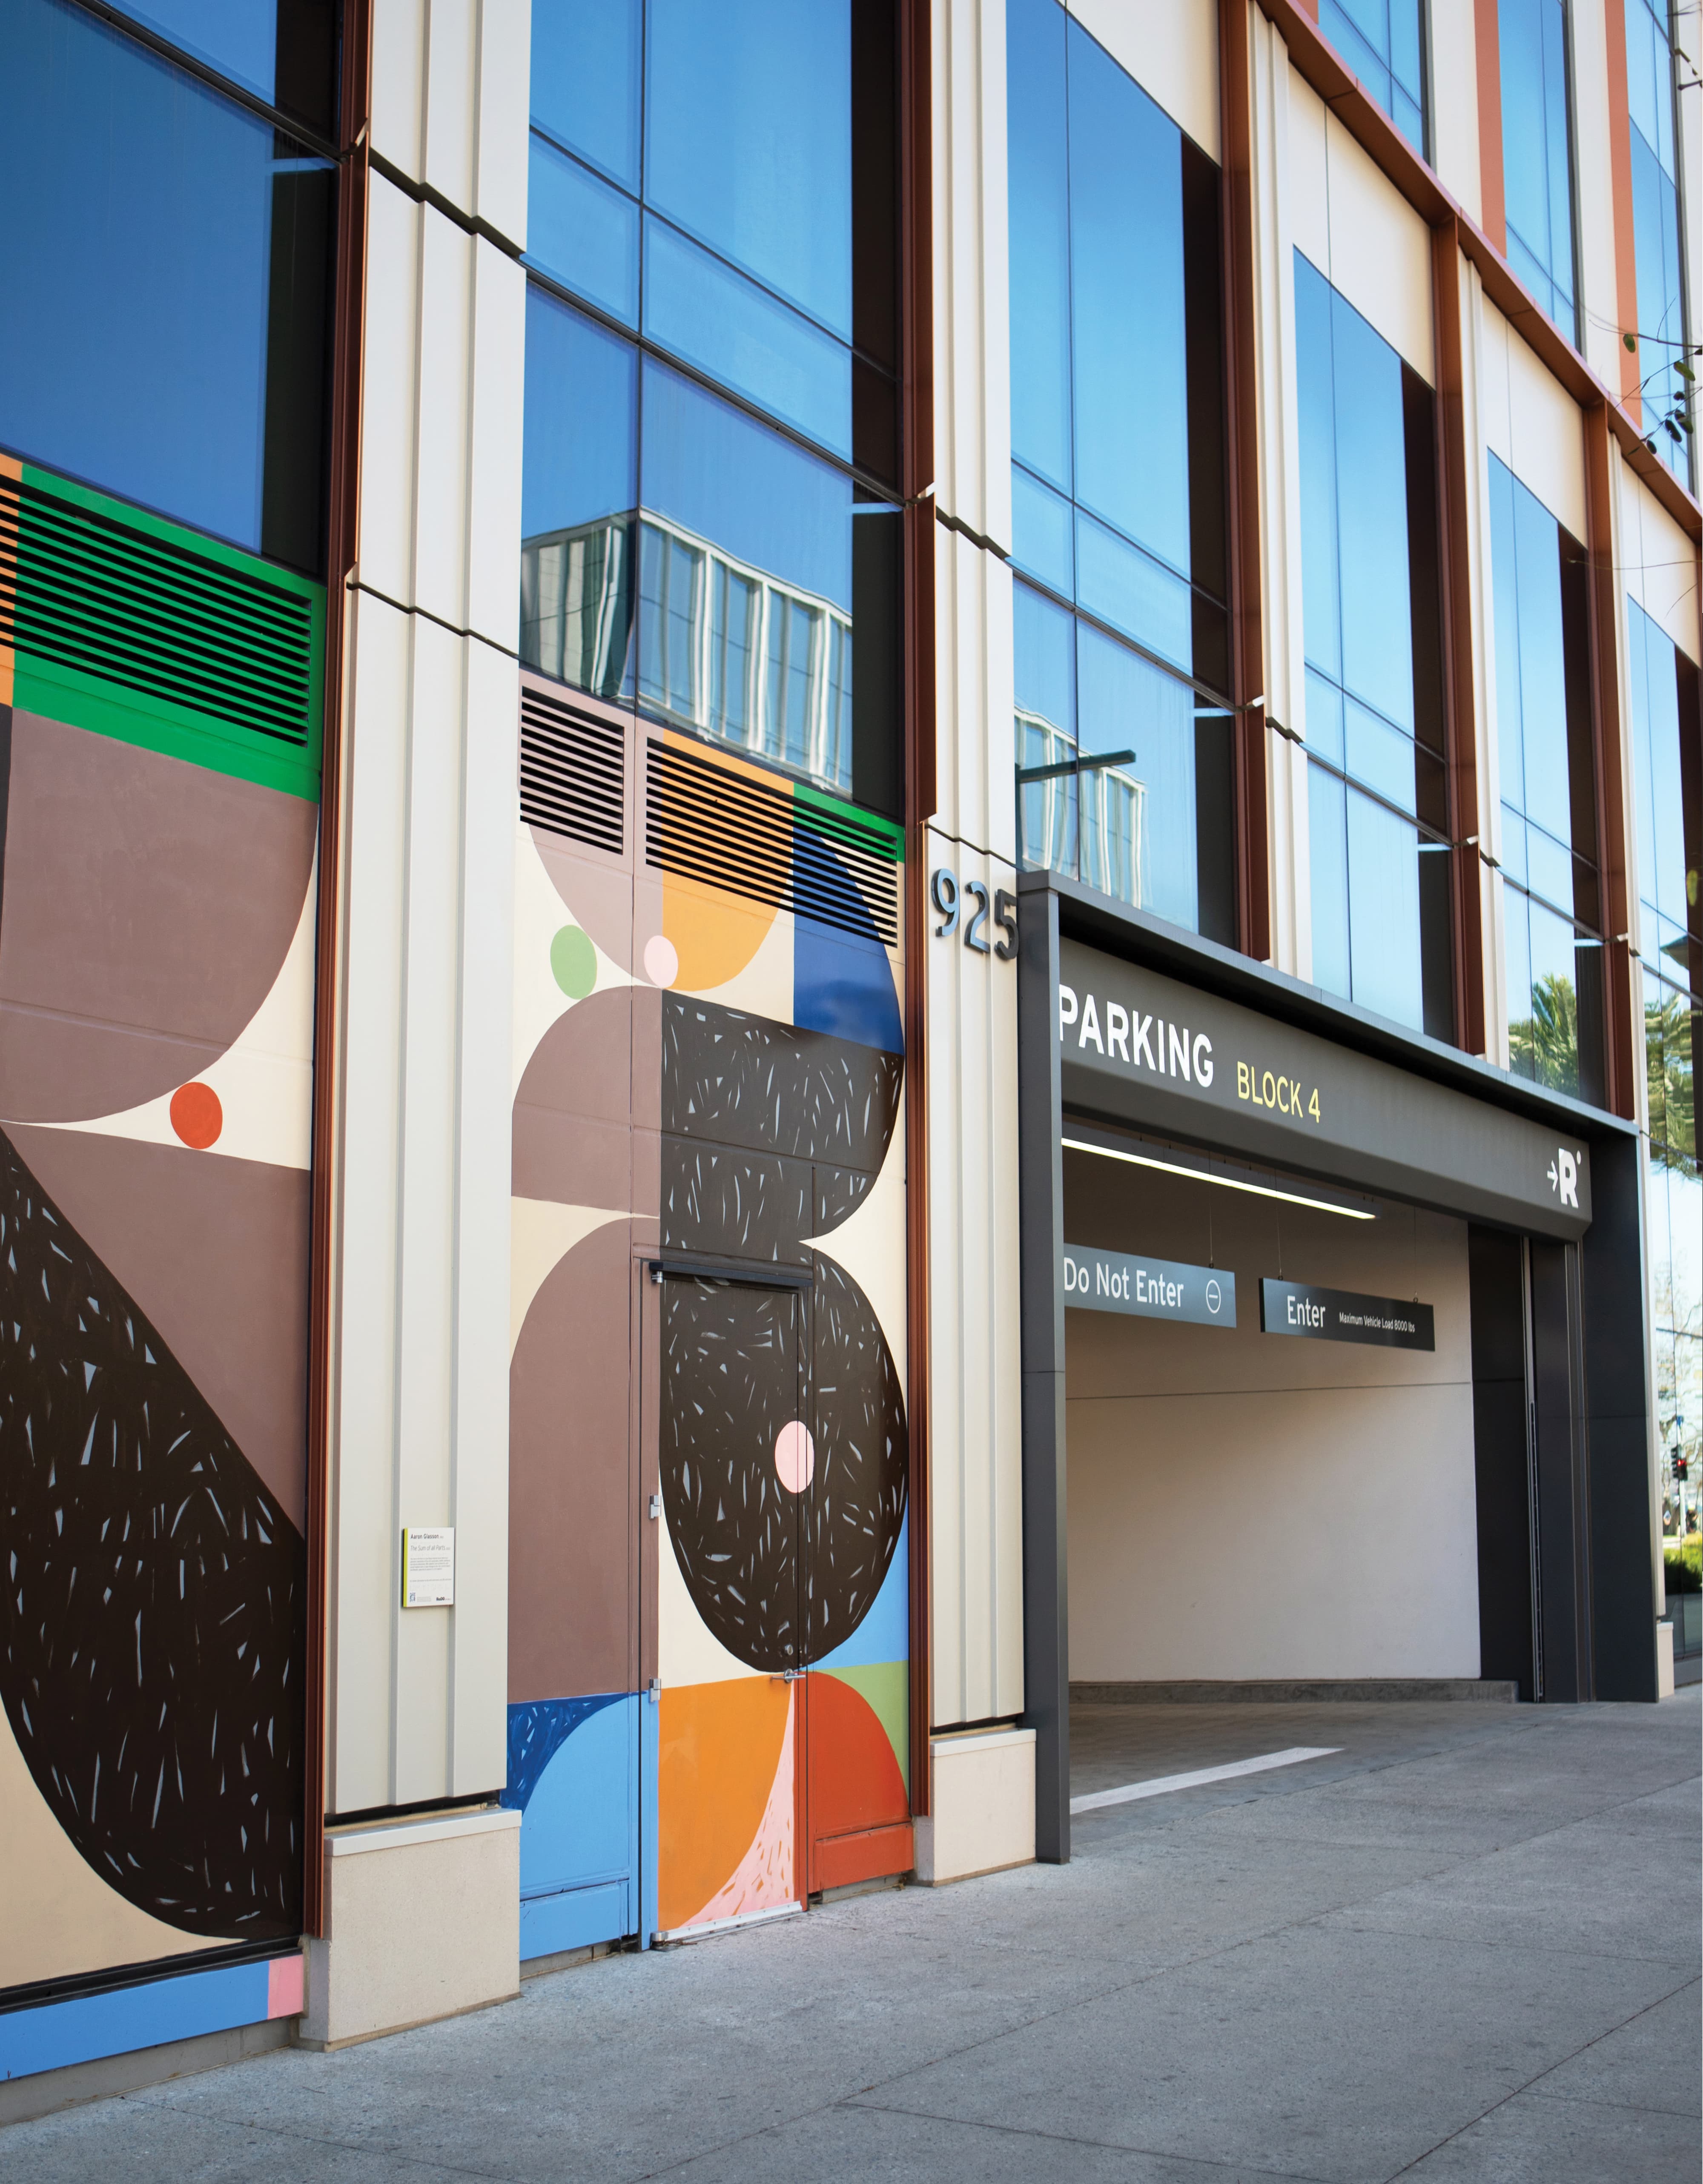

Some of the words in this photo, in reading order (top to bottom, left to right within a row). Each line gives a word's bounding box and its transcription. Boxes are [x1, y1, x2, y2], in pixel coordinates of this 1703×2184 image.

[932, 868, 1019, 959] 925
[1059, 984, 1213, 1088] PARKING
[1237, 1061, 1303, 1118] BLOCK
[1308, 1088, 1321, 1123] 4
[1064, 1257, 1089, 1293] Do
[1096, 1262, 1130, 1300] Not
[1136, 1269, 1184, 1307] Enter
[1287, 1295, 1325, 1328] Enter
[1339, 1312, 1363, 1325] Maximum
[1364, 1315, 1381, 1328] Vehicle
[1382, 1318, 1393, 1330] Load
[1394, 1320, 1407, 1332] 8000
